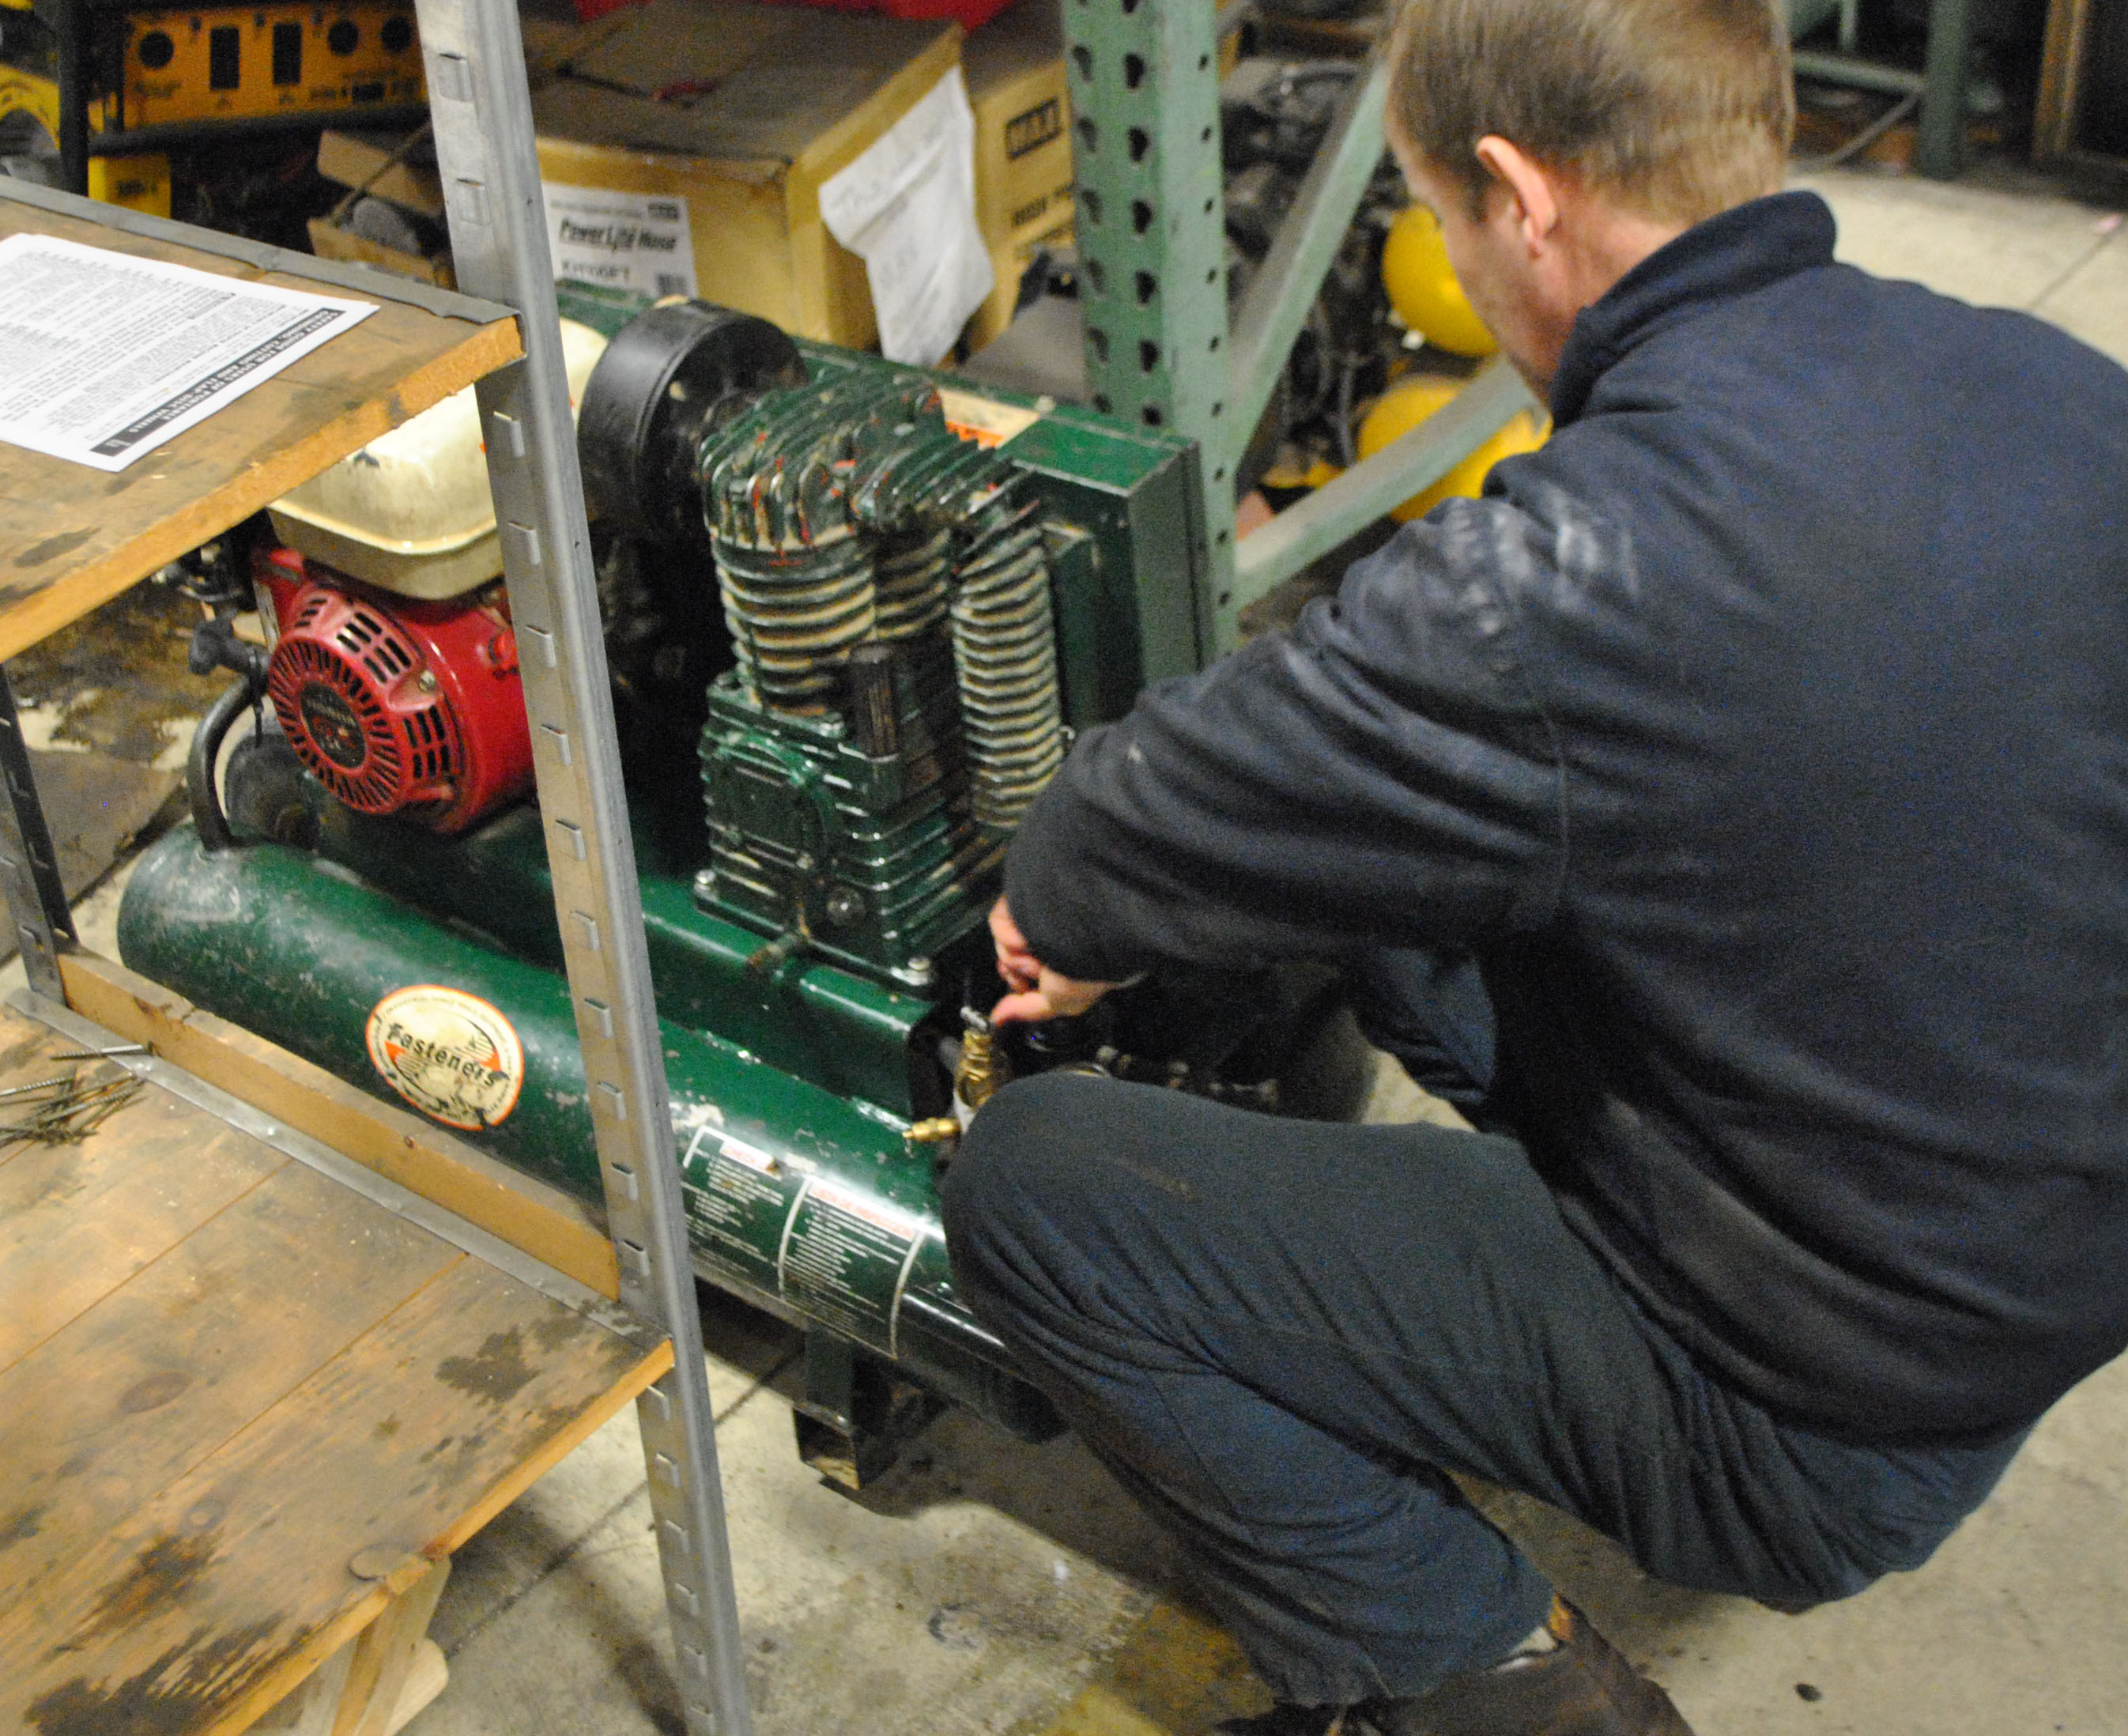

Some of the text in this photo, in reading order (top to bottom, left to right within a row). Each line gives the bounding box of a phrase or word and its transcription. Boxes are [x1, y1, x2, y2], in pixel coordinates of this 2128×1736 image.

[253, 349, 278, 362] FOR
[214, 364, 242, 379] AND
[207, 380, 228, 391] OF
[160, 389, 213, 421] PORTABLE
[126, 407, 172, 433] WHEELS
[387, 1023, 496, 1086] Fasteners
